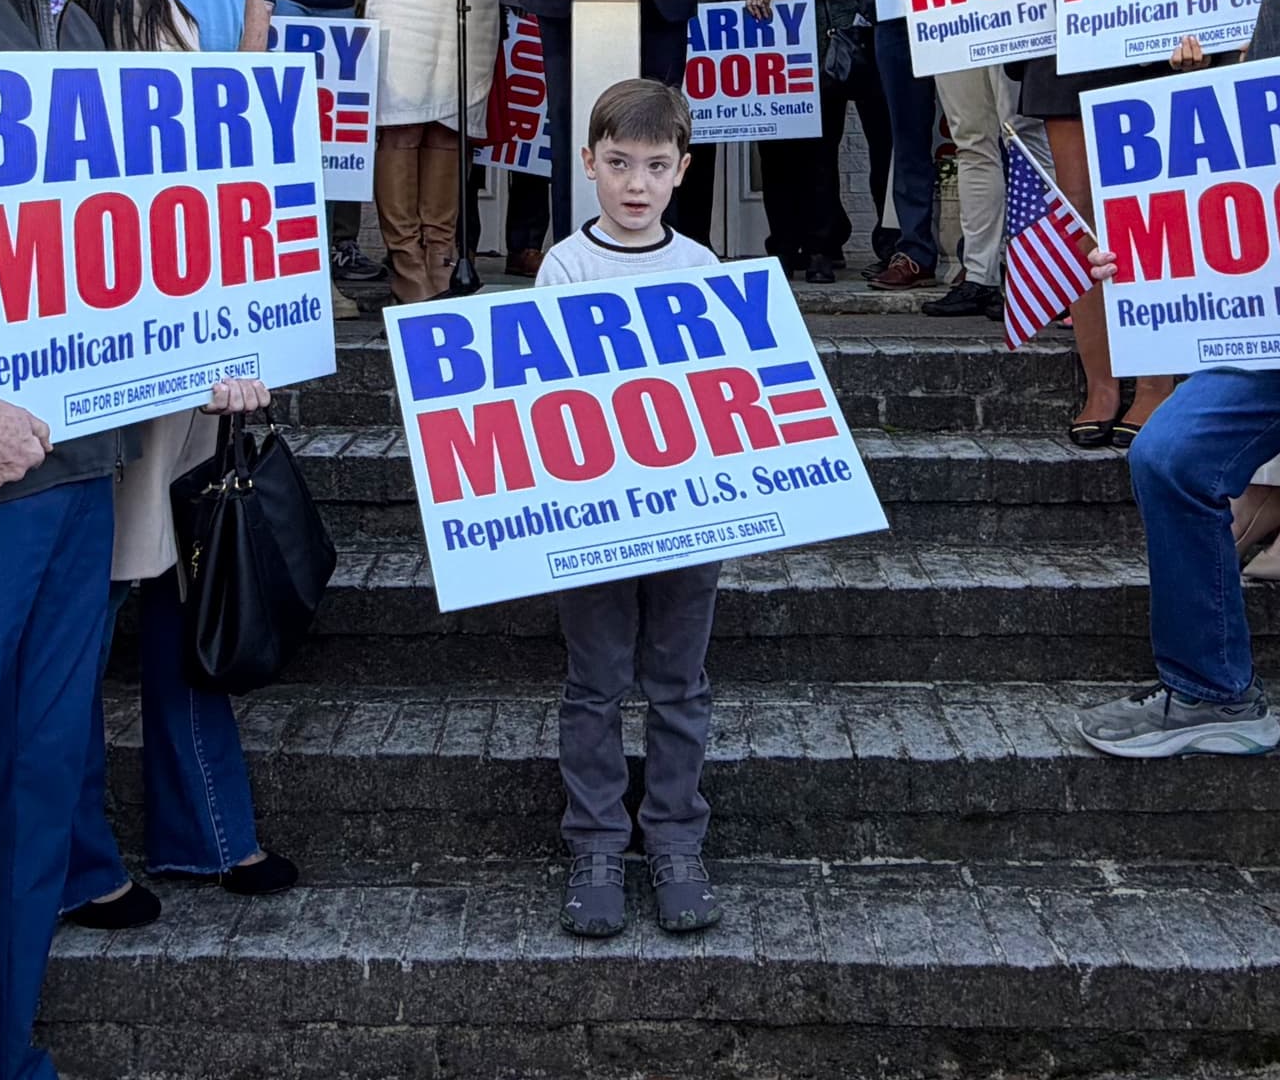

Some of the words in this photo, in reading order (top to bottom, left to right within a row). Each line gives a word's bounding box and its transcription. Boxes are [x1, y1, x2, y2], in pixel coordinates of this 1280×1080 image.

[916, 9, 1012, 43] Republican
[1016, 2, 1048, 24] For
[1066, 2, 1178, 36] Republican
[1129, 40, 1145, 53] PAID
[1146, 37, 1161, 50] FOR
[1162, 36, 1171, 48] BY
[1199, 28, 1225, 41] MOORE
[1226, 25, 1241, 38] FOR
[972, 44, 986, 57] PAID
[987, 43, 999, 55] FOR
[1000, 42, 1009, 53] BY
[1009, 39, 1029, 51] BARRY
[1030, 36, 1052, 48] MOORE
[685, 52, 814, 100] OORE
[717, 105, 738, 118] For
[741, 102, 766, 117] U.S.
[771, 101, 814, 115] Senate
[322, 152, 365, 170] enate
[143, 318, 185, 352] For
[193, 305, 239, 343] U.S.
[247, 292, 322, 333] Senate
[1118, 292, 1265, 331] Republican
[398, 270, 778, 401] BARRY
[1204, 344, 1223, 357] PAID
[1225, 342, 1244, 355] FOR
[1246, 341, 1259, 354] BY
[70, 400, 91, 417] PAID
[93, 394, 112, 412] FOR
[114, 390, 126, 407] BY
[127, 383, 156, 403] BARRY
[158, 376, 187, 396] MOORE
[189, 371, 206, 389] FOR
[225, 360, 256, 378] SENATE
[417, 361, 839, 504] MOORE
[441, 497, 621, 552] Republican
[626, 487, 677, 521] For
[684, 472, 747, 508] U.S.
[756, 455, 852, 495] Senate
[554, 553, 579, 573] PAID
[580, 549, 602, 567] FOR
[604, 546, 619, 563] BY
[620, 540, 655, 560] BARRY
[657, 534, 692, 554] MOORE
[694, 529, 716, 547] FOR
[718, 525, 738, 543] U.S.
[738, 517, 778, 539] SENATE
